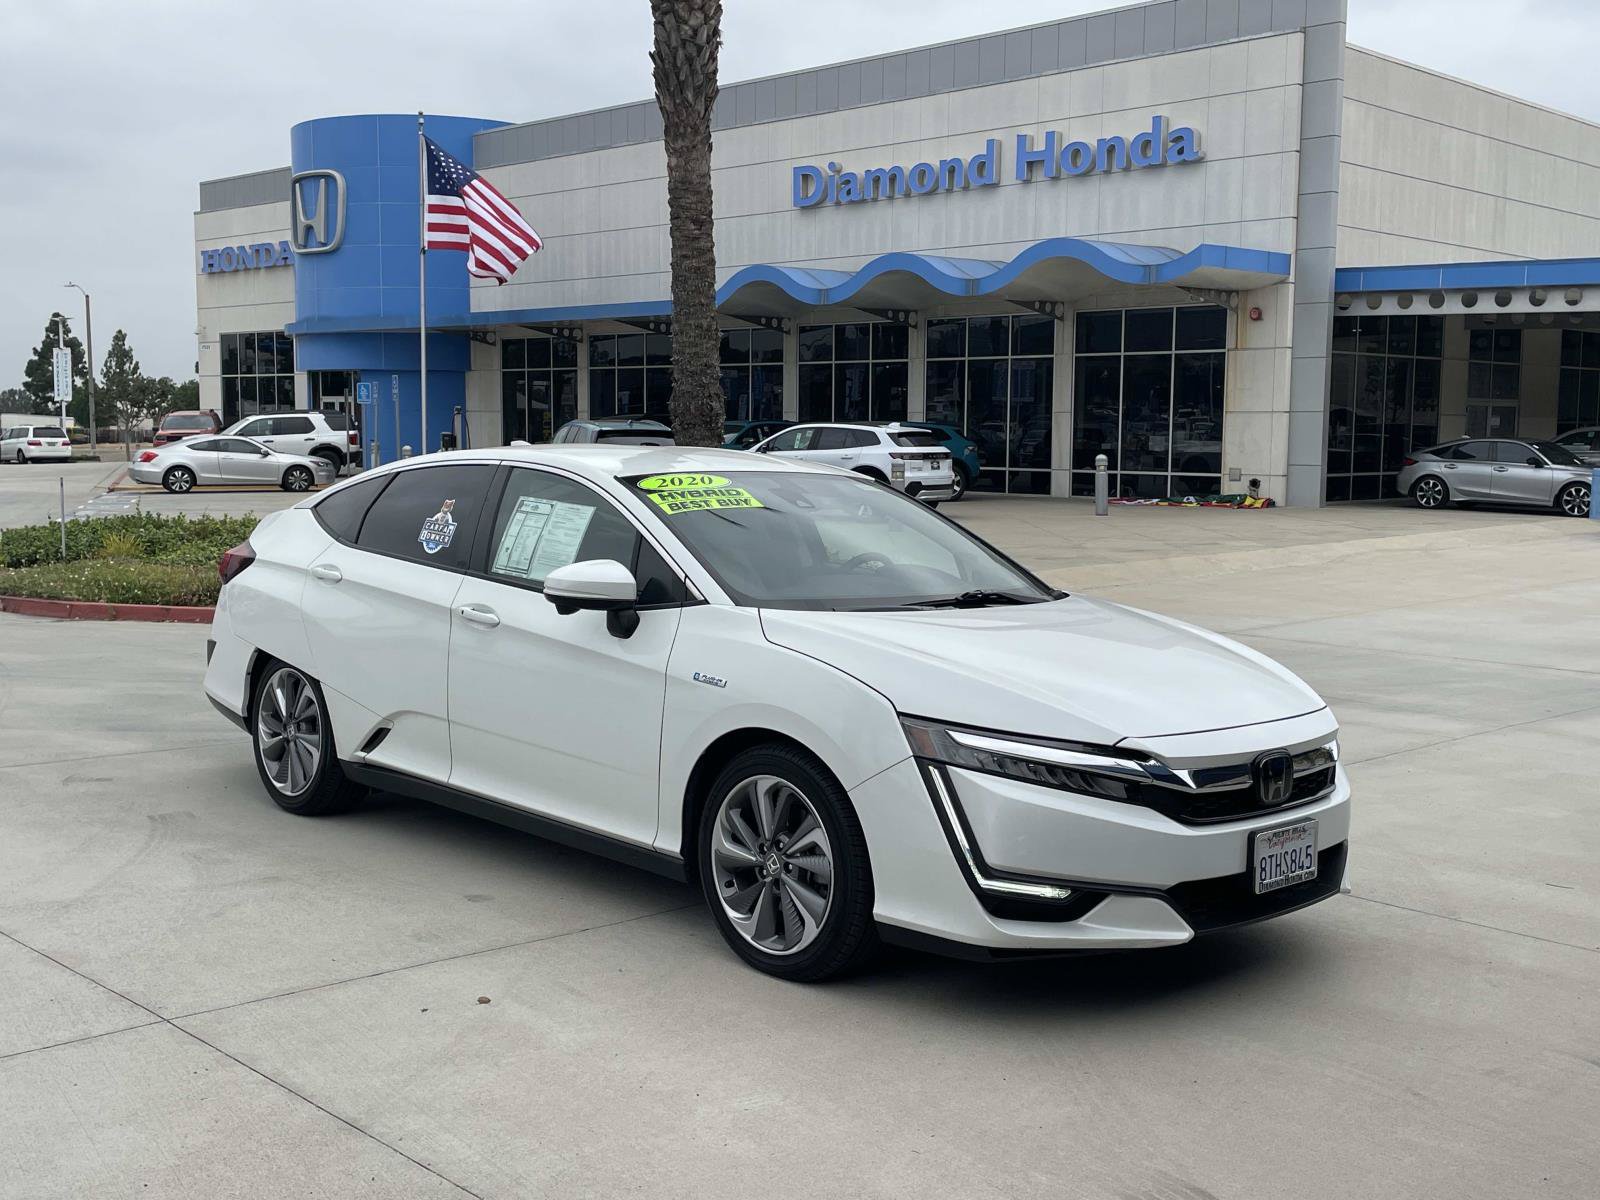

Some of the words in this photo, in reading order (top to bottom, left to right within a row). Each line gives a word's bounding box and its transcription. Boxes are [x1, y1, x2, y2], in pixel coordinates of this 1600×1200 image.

[793, 139, 1001, 209] Diamond
[1016, 115, 1205, 181] Honda
[200, 240, 295, 274] HONDA
[655, 476, 713, 488] 2020
[657, 489, 745, 501] HYBRID
[667, 500, 711, 512] BEST
[718, 498, 751, 507] BUY
[1260, 844, 1313, 881] 8THS845
